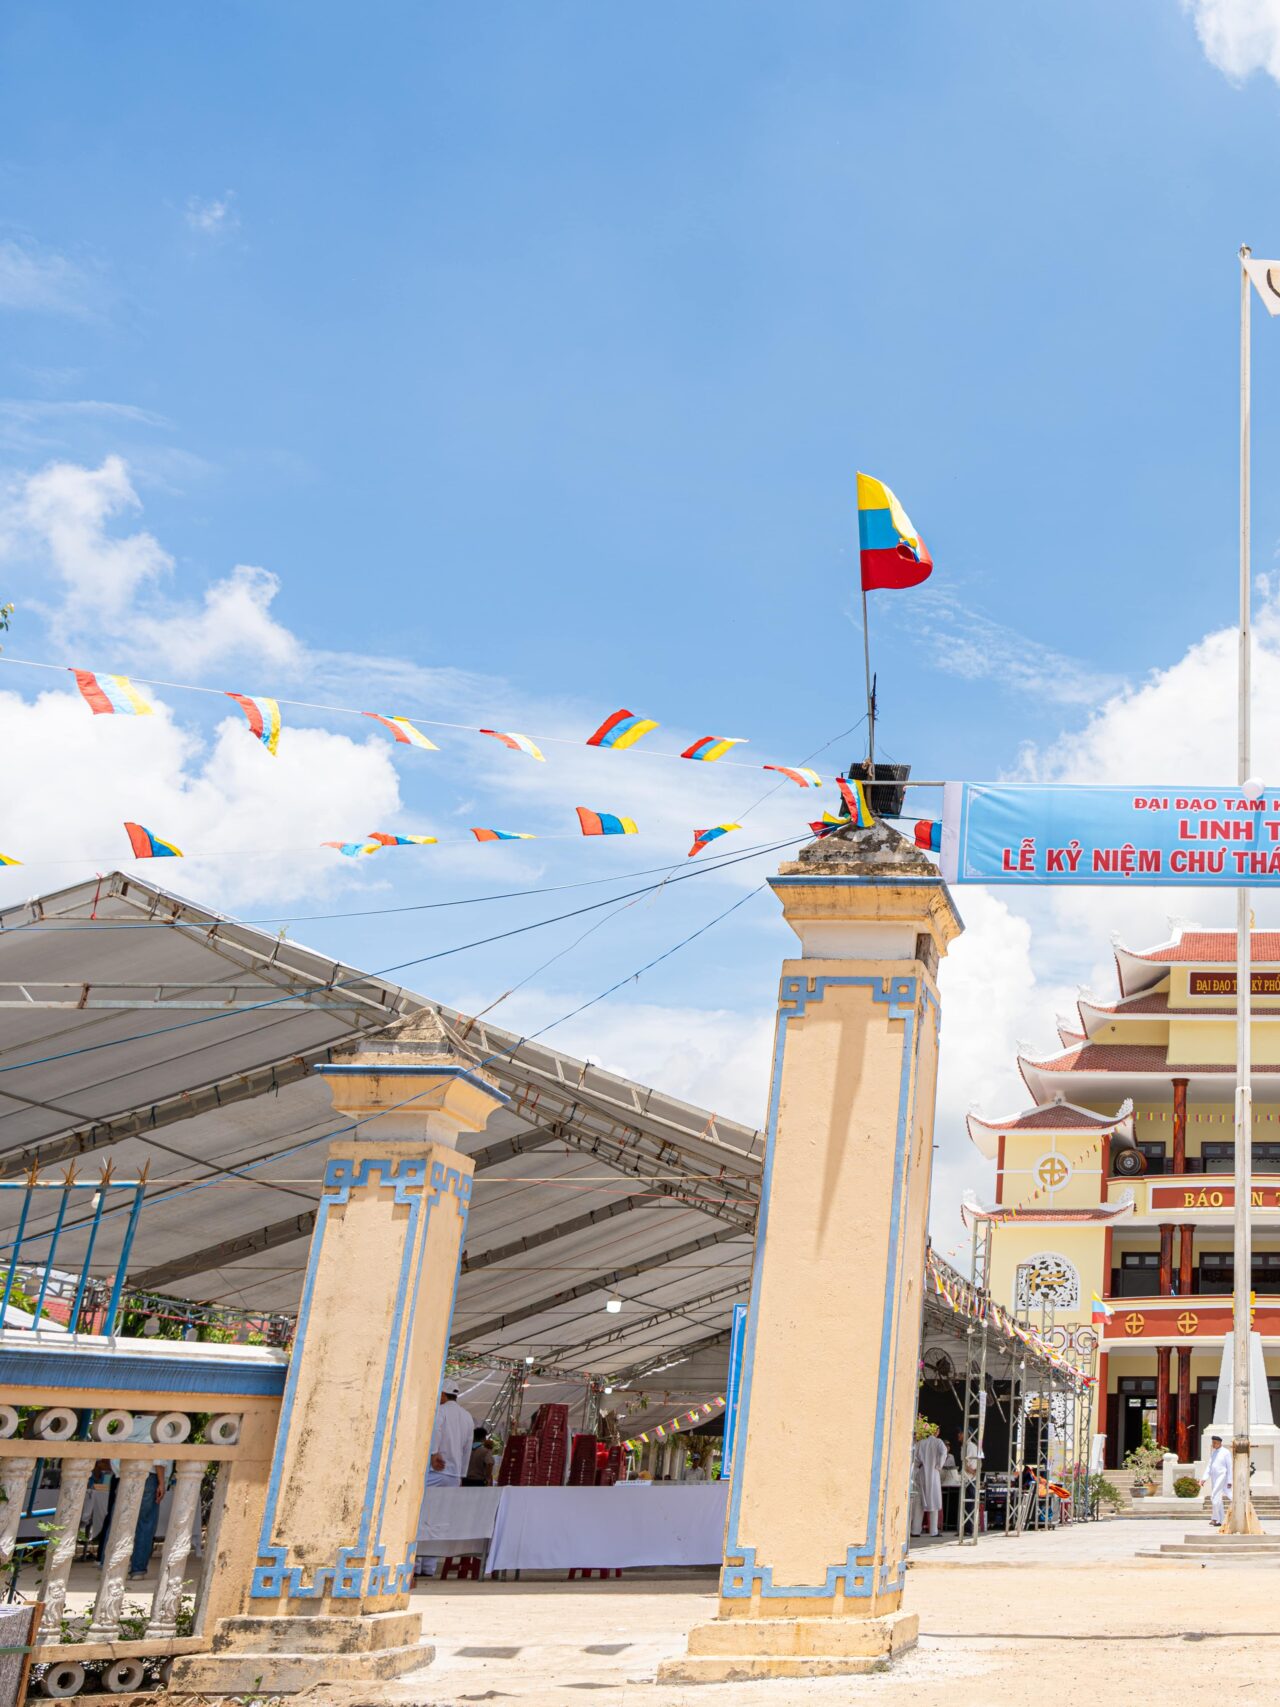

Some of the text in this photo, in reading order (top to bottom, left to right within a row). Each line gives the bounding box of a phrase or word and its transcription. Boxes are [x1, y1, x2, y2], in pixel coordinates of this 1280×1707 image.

[1134, 798, 1168, 812] ĐẠI
[1175, 798, 1217, 812] ĐẠO
[1223, 799, 1266, 811] TAM
[1179, 820, 1253, 840] LINH
[1003, 838, 1036, 871] LỄ
[1047, 841, 1082, 871] KỶ
[1093, 844, 1159, 876] NIỆM
[1170, 847, 1227, 873] CHƯ
[1196, 980, 1211, 994] ĐẠI
[1213, 980, 1231, 994] ĐẠO
[1183, 1187, 1223, 1207] BÁO
